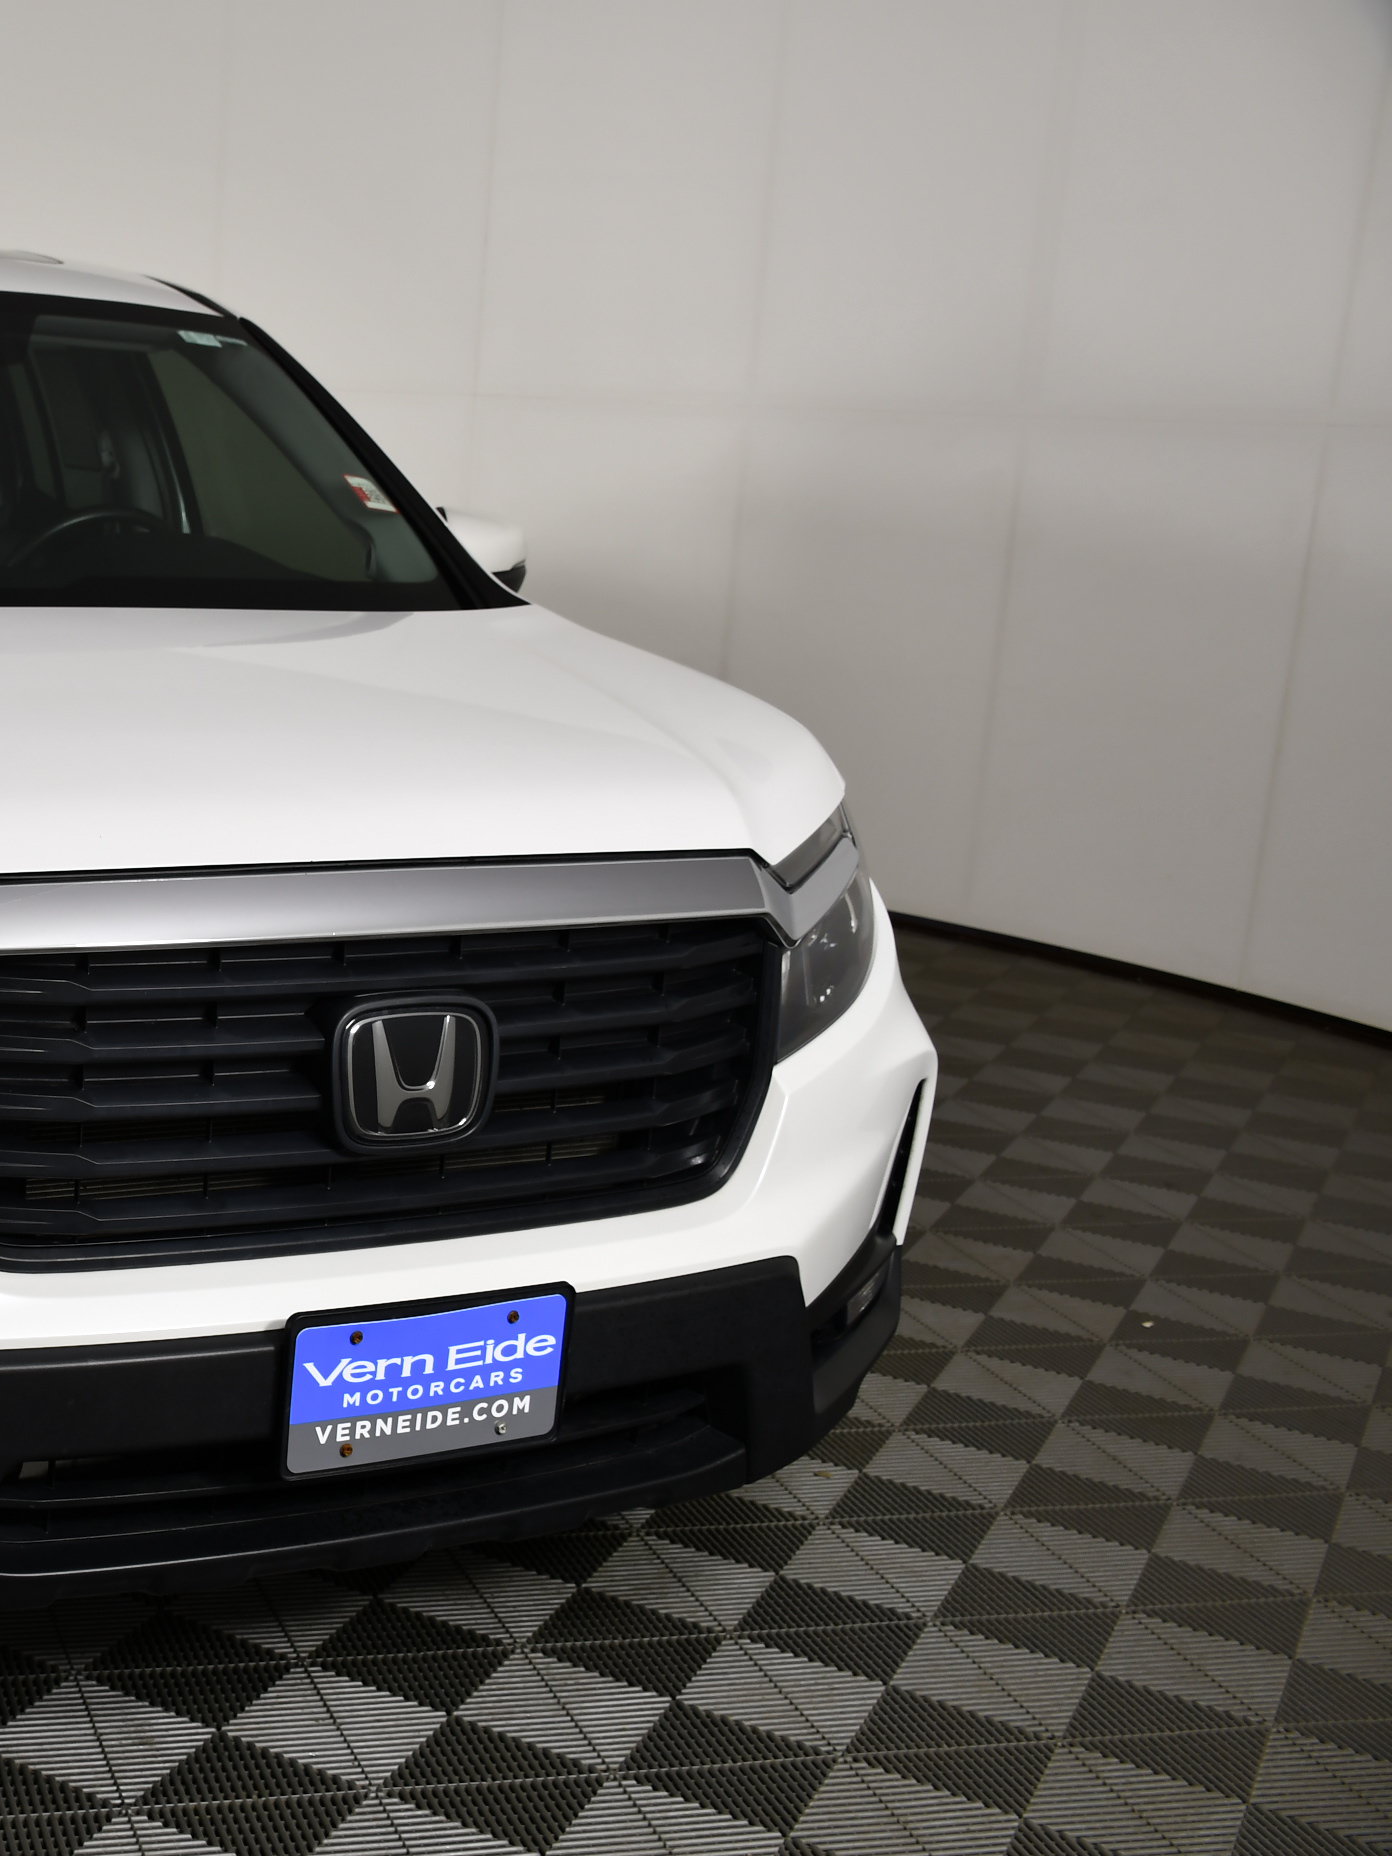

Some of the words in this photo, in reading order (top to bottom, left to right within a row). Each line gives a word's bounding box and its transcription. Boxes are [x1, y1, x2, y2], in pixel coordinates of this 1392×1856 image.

[302, 1353, 435, 1387] Vern
[445, 1332, 557, 1371] Eide
[342, 1367, 524, 1408] MOTORCARS
[315, 1394, 531, 1445] VERNEIDE.COM
